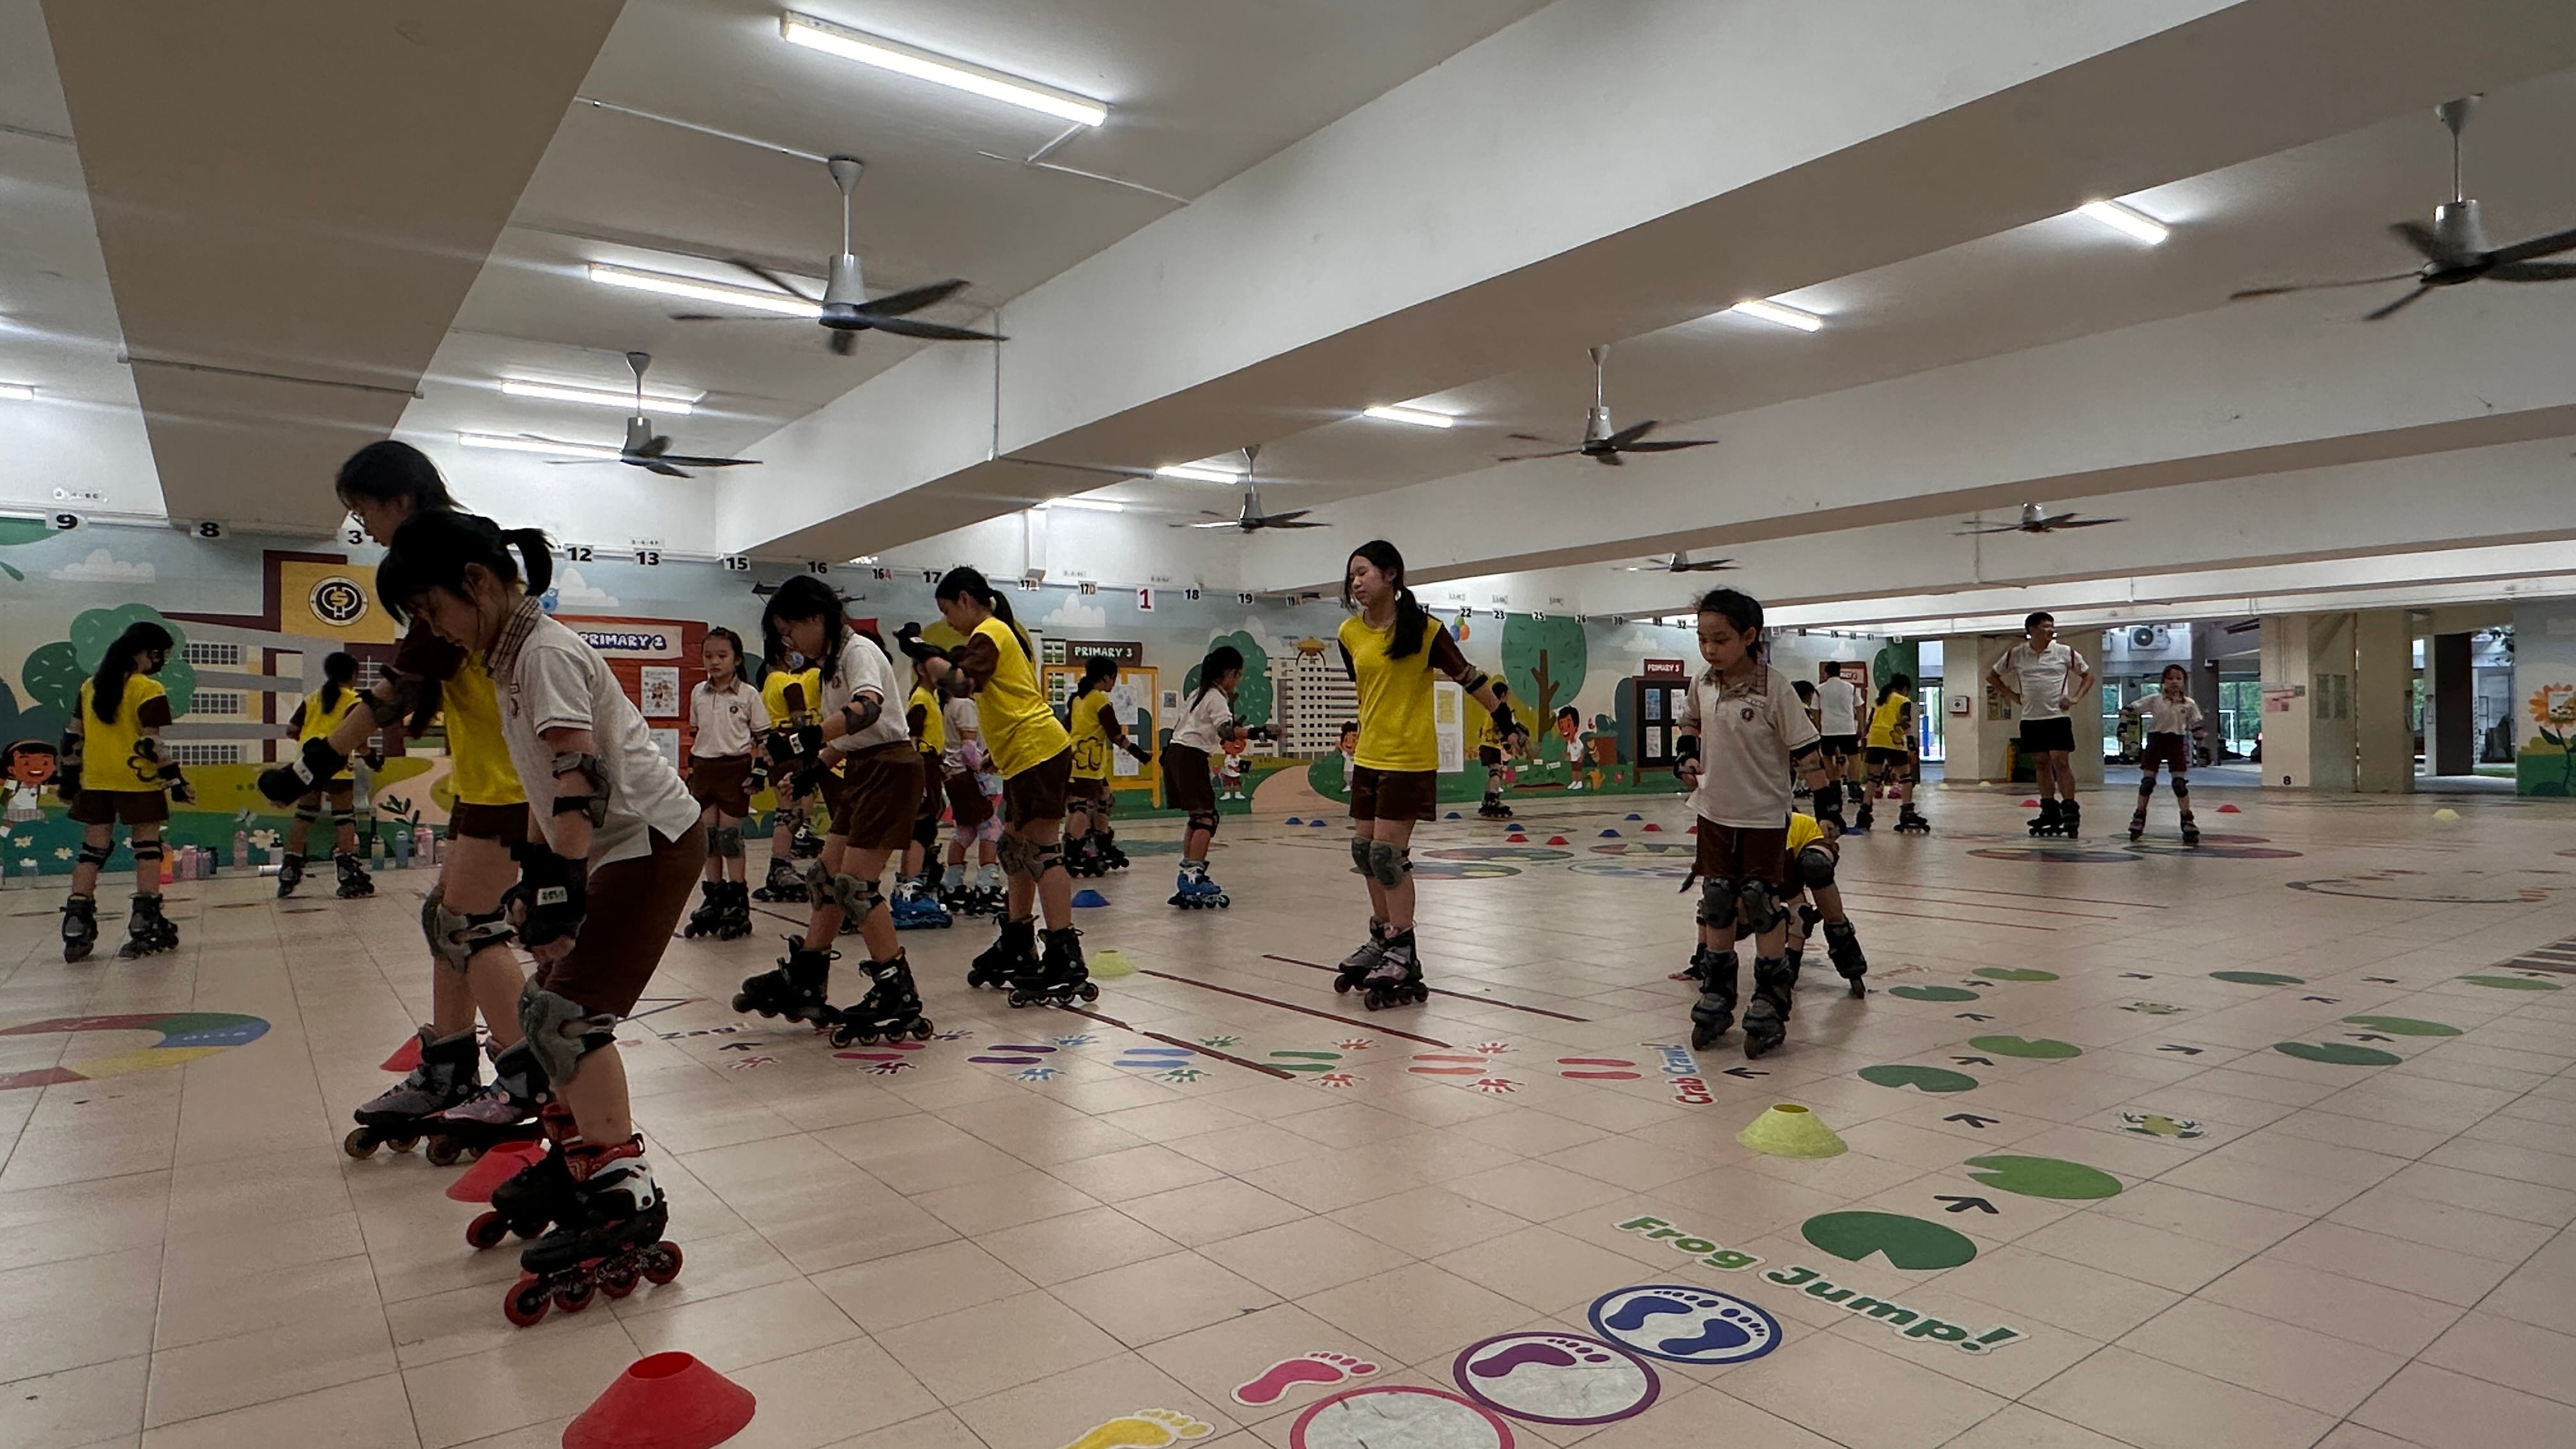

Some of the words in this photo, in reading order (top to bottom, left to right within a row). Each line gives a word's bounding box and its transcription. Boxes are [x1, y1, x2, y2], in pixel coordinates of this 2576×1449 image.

[56, 514, 78, 530] 9
[199, 522, 220, 537] 8
[348, 530, 362, 544] 3
[567, 547, 592, 562] 12
[636, 551, 659, 565] 13
[726, 556, 747, 570] 15
[808, 561, 827, 574] 16
[872, 567, 892, 580] 16A
[923, 571, 942, 584] 17
[1139, 588, 1151, 610] 1
[1184, 588, 1200, 601] 18
[1239, 593, 1253, 604] 19
[1460, 608, 1471, 617] 22
[1494, 610, 1505, 619] 23
[1533, 611, 1544, 620] 25
[1576, 614, 1586, 624] 26
[578, 632, 650, 649] PRIMARY
[653, 635, 666, 650] 2
[1074, 646, 1123, 658] PRIMARY
[1126, 647, 1133, 658] 3
[2283, 776, 2292, 786] 8
[1667, 1077, 1713, 1104] Crab
[1618, 1215, 1759, 1270] Frog
[1766, 1265, 2019, 1352] Jump!
